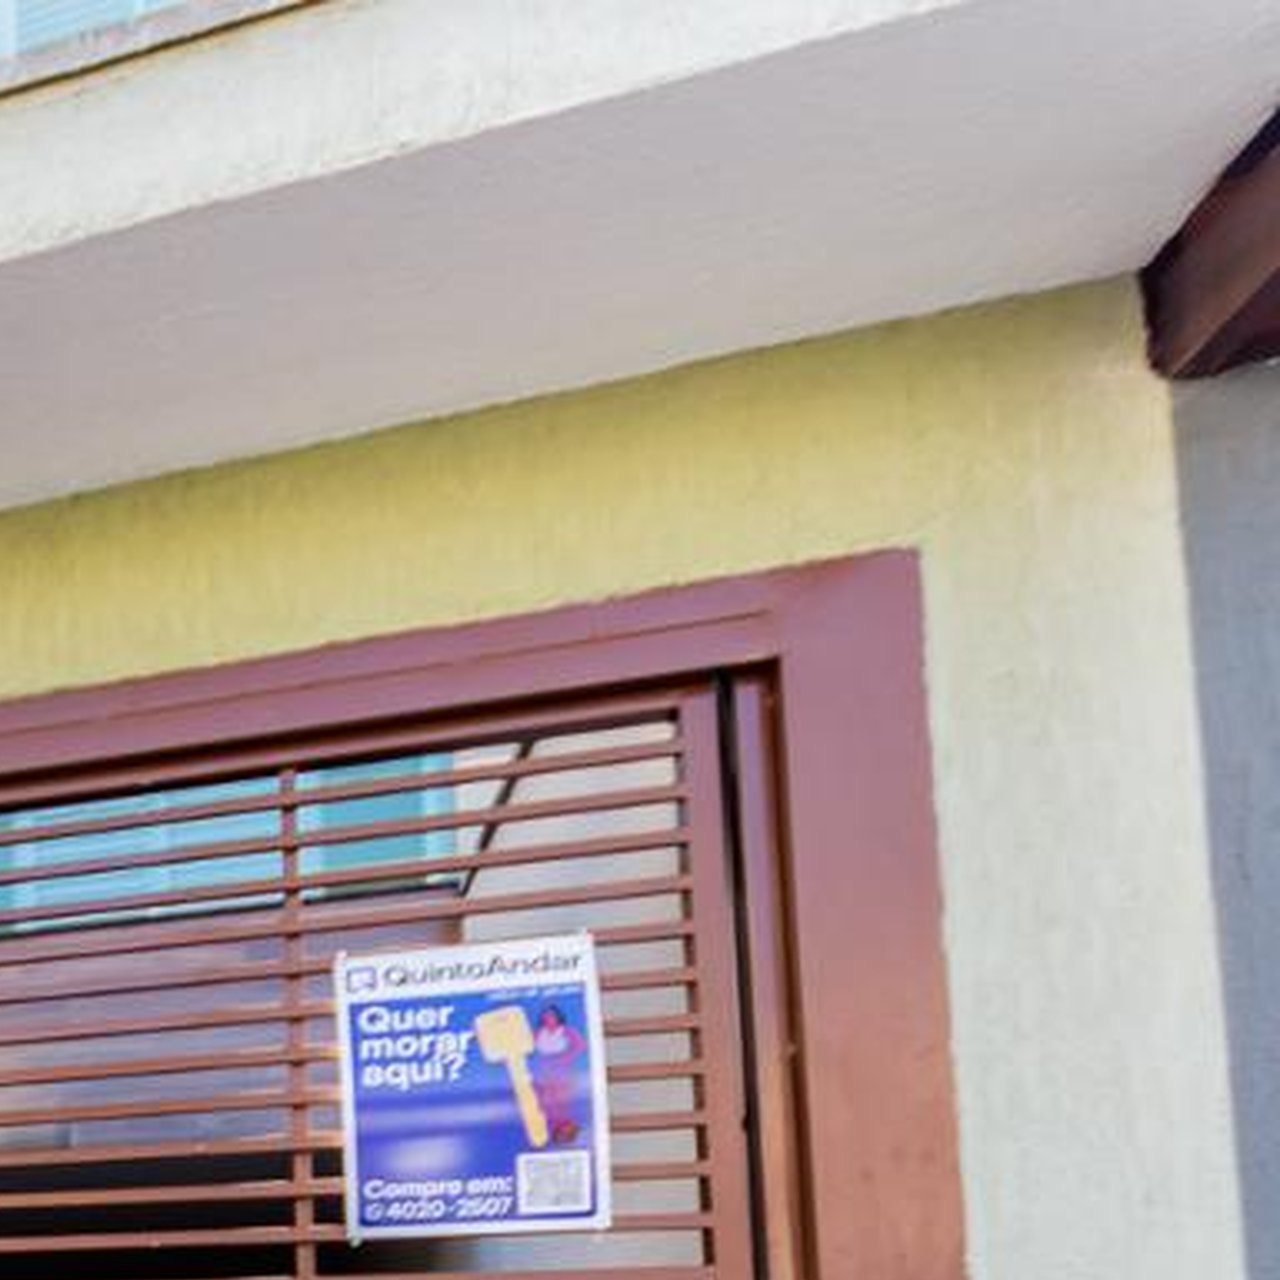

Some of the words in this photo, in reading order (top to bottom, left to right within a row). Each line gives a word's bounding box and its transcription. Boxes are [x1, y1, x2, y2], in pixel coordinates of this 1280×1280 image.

[384, 953, 582, 986] QuintoAndar
[358, 1005, 454, 1033] Quer
[360, 1031, 474, 1059] morar
[361, 1053, 465, 1090] aqui?
